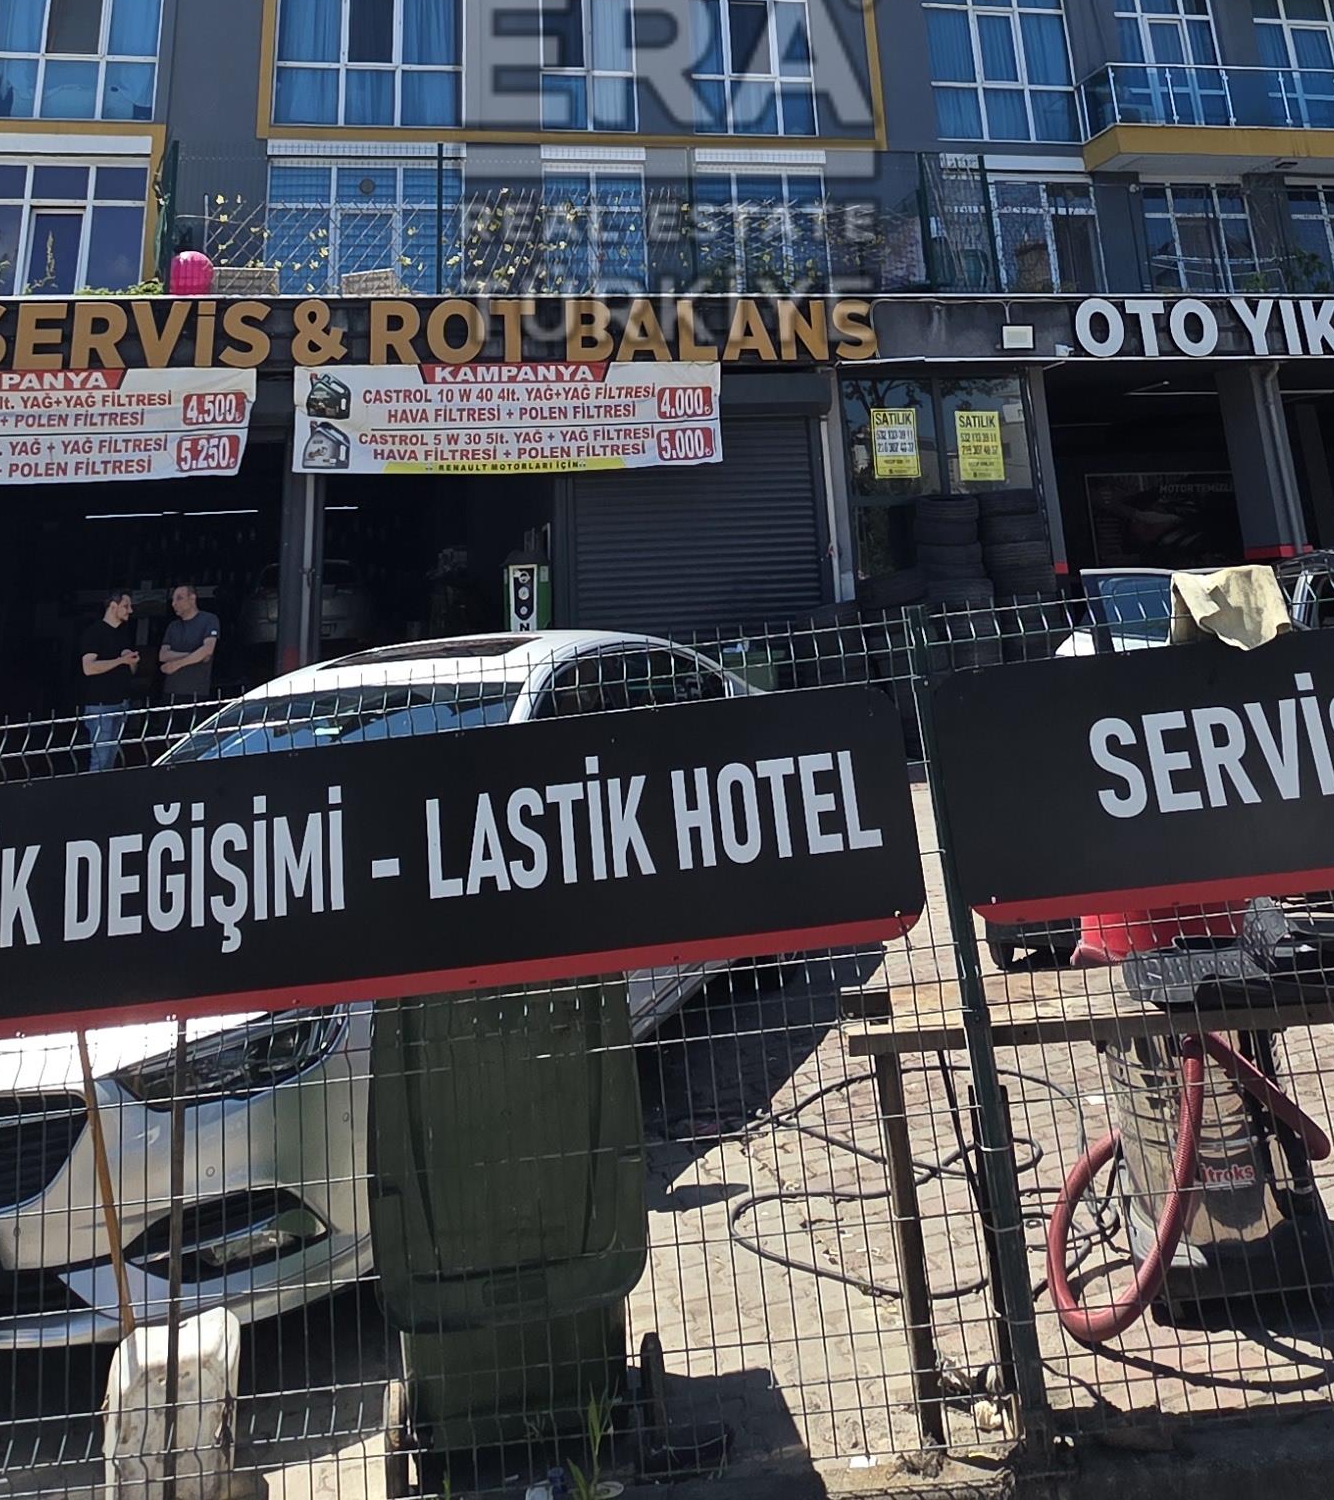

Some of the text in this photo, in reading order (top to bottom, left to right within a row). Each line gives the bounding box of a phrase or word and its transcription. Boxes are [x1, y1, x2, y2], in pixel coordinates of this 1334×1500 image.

[292, 299, 348, 365] &
[370, 299, 535, 365] ROT
[567, 298, 877, 361] BALANS
[1075, 297, 1219, 358] OTO
[434, 365, 594, 383] KAMPANYA
[101, 390, 172, 408] FİLTRESİ
[362, 389, 433, 404] CASTROL
[437, 388, 454, 402] 10
[458, 388, 472, 402] W
[475, 387, 493, 402] 40
[594, 382, 656, 400] FİLTRESİ
[0, 416, 9, 426] +
[14, 412, 69, 428] POLEN
[73, 408, 145, 427] FİLTRESİ
[387, 401, 636, 424] HAVA FİLTRESİ + POLEN FİLTRESİ
[875, 412, 912, 426] SATILIK
[958, 414, 996, 428] SATILIK
[9, 438, 42, 457] YAĞ
[62, 437, 93, 455] YAĞ
[98, 434, 168, 454] FİLTRESİ
[358, 433, 429, 446] CASTROL
[433, 433, 442, 445] 5
[446, 433, 460, 445] W
[464, 433, 482, 445] 30
[513, 429, 543, 444] YAĞ
[559, 427, 589, 442] YAĞ
[593, 424, 655, 442] FİLTRESİ
[373, 440, 646, 461] HAVA FİLTRESİ + POLEN FİLTRESİ
[8, 462, 68, 478] POLEN
[74, 455, 152, 476] FİLTRESİ
[438, 463, 487, 472] RENAULT
[491, 461, 553, 471] MOTORLARI
[63, 803, 346, 955] DEĞİŞİMİ
[425, 754, 655, 901] LASTİK
[672, 747, 884, 871] HOTEL
